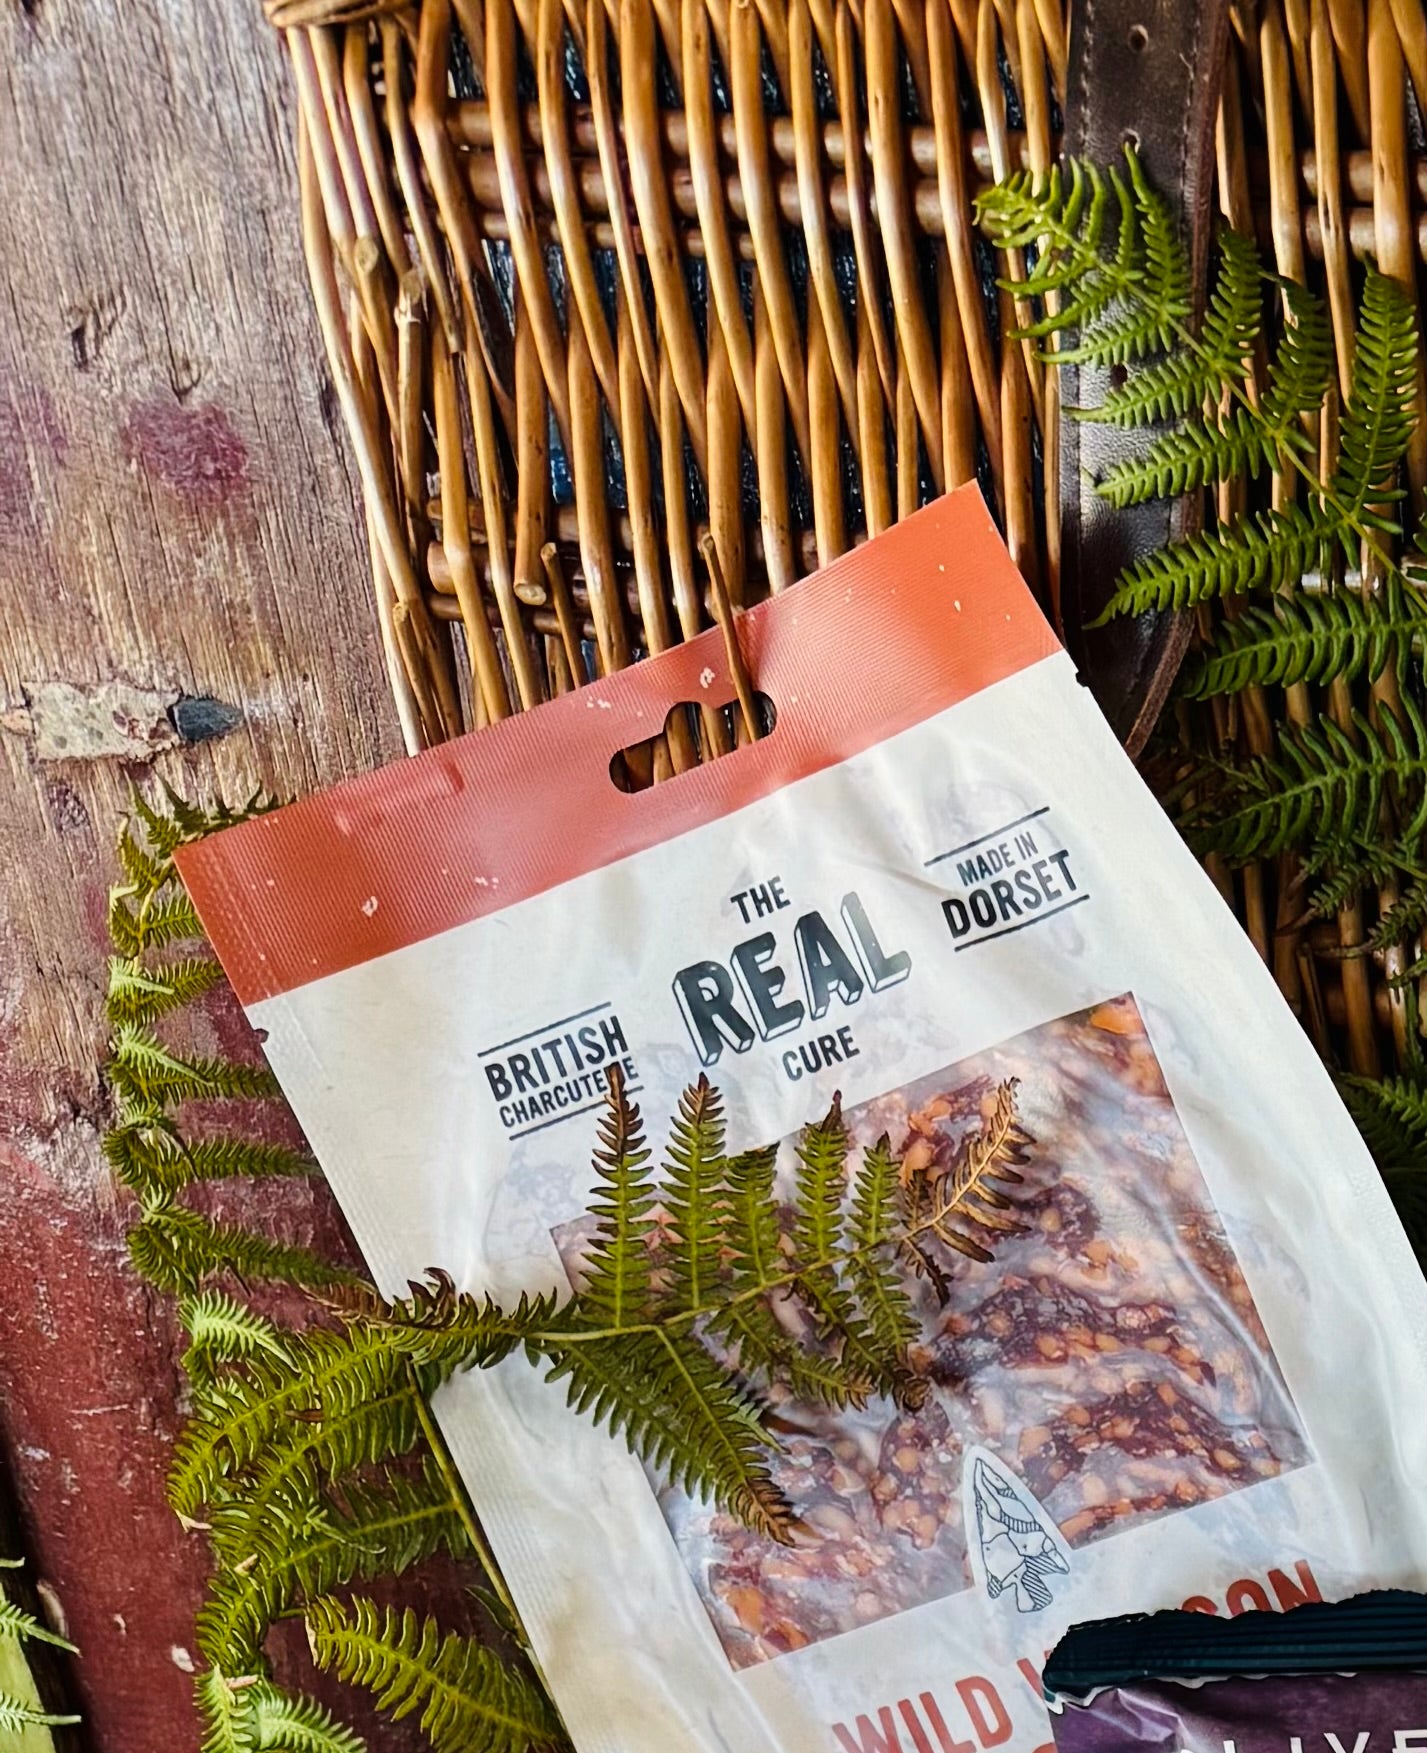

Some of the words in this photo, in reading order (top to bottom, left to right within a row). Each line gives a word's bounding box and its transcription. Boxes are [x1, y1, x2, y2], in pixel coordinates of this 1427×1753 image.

[730, 877, 791, 924] THE
[940, 849, 1079, 938] DORSET
[671, 891, 913, 1067] REAL
[484, 1014, 630, 1101] BRITISH
[781, 1026, 860, 1082] CURE
